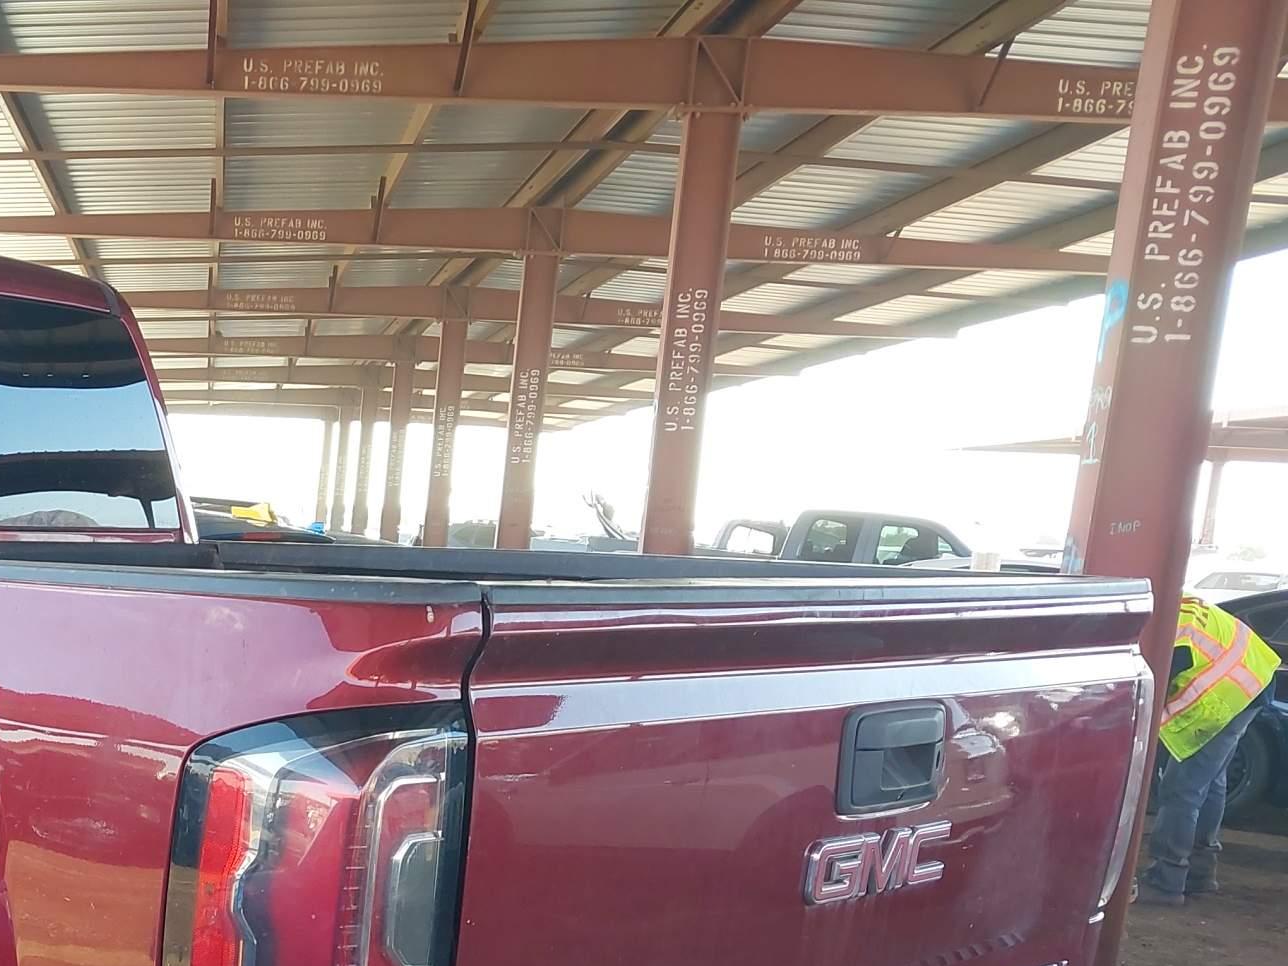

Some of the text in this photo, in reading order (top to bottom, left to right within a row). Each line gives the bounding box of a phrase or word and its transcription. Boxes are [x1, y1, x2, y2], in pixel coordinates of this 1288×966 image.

[243, 58, 384, 76] U.S. PREFAB INC.
[1058, 79, 1090, 96] U.S.
[234, 216, 327, 229] U.S. PREFAB INC.
[1130, 44, 1208, 344] U.S. PREFAB INC.
[1164, 47, 1241, 342] 1-866-799-0969
[764, 235, 785, 247] U.S.
[792, 237, 836, 249] PREFAB
[664, 288, 693, 432] U.S. PREFAB INC.
[681, 289, 709, 430] 1-866-799-0969
[802, 819, 953, 906] GMC
